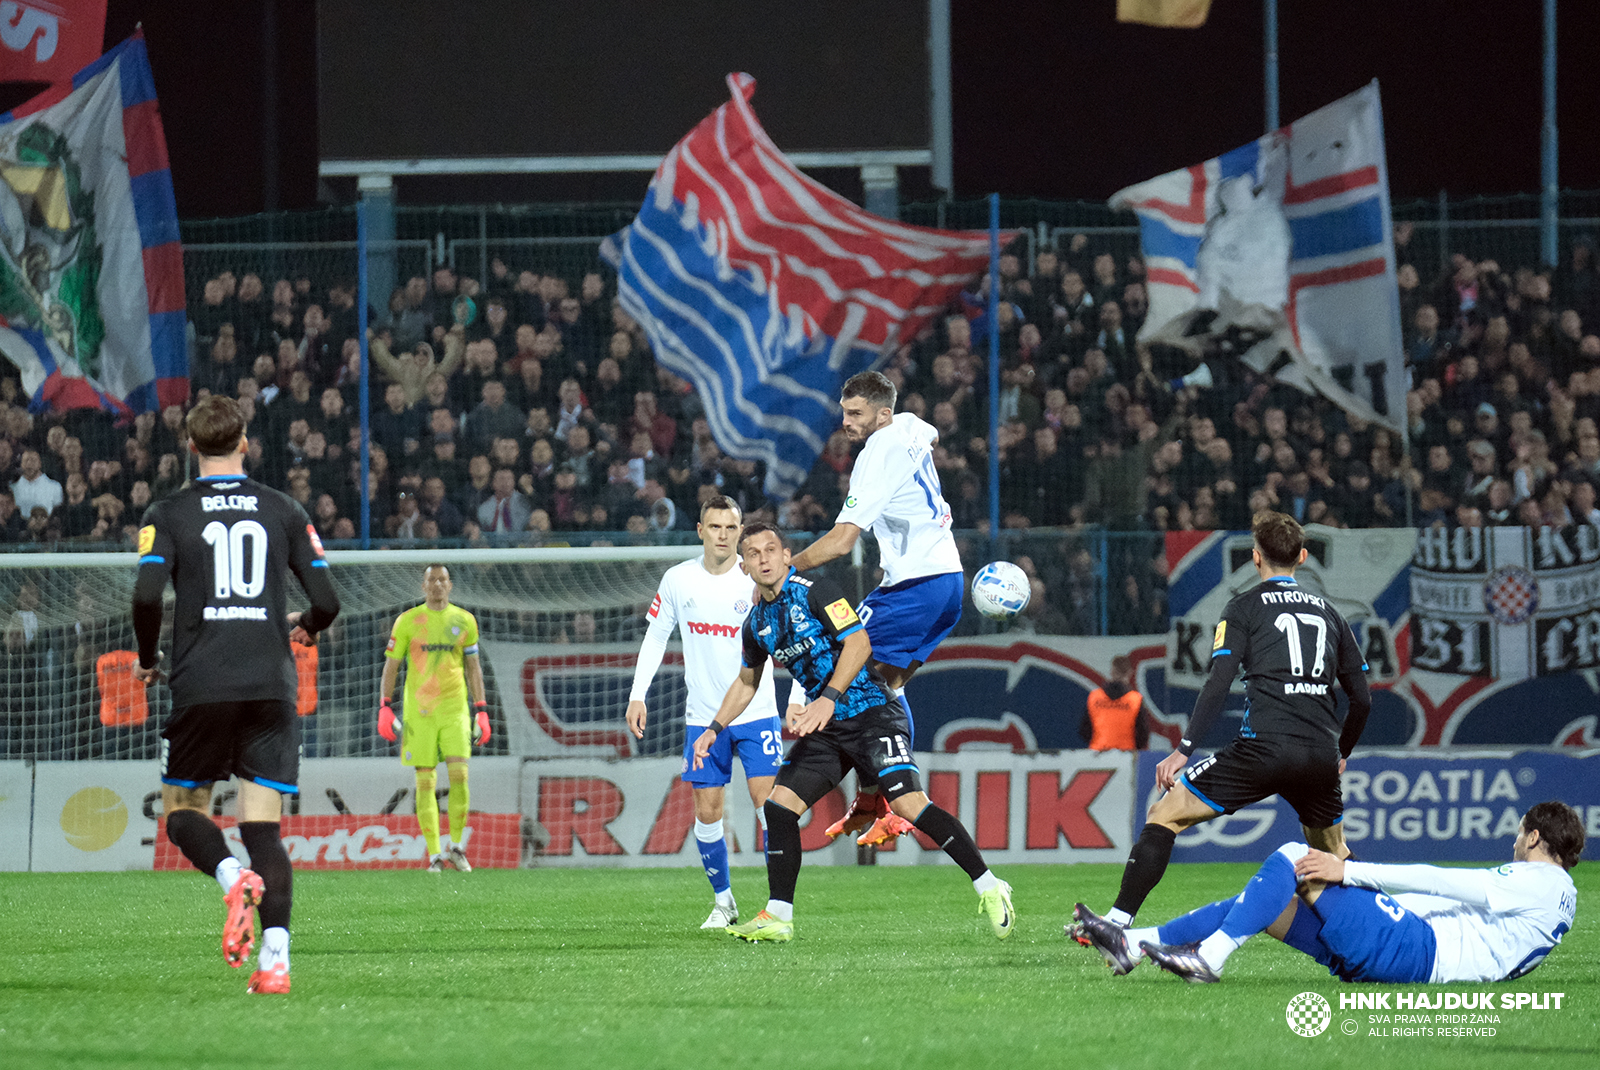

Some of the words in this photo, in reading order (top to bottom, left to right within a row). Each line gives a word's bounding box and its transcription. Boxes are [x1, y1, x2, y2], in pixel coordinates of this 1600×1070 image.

[201, 494, 258, 512] BELCAR
[201, 519, 268, 599] 10
[1260, 590, 1326, 610] MITROVSKI
[202, 606, 268, 621] RADNIK
[687, 621, 741, 638] TOMMY
[1273, 612, 1327, 678] 17
[1341, 769, 1520, 804] ROATIA
